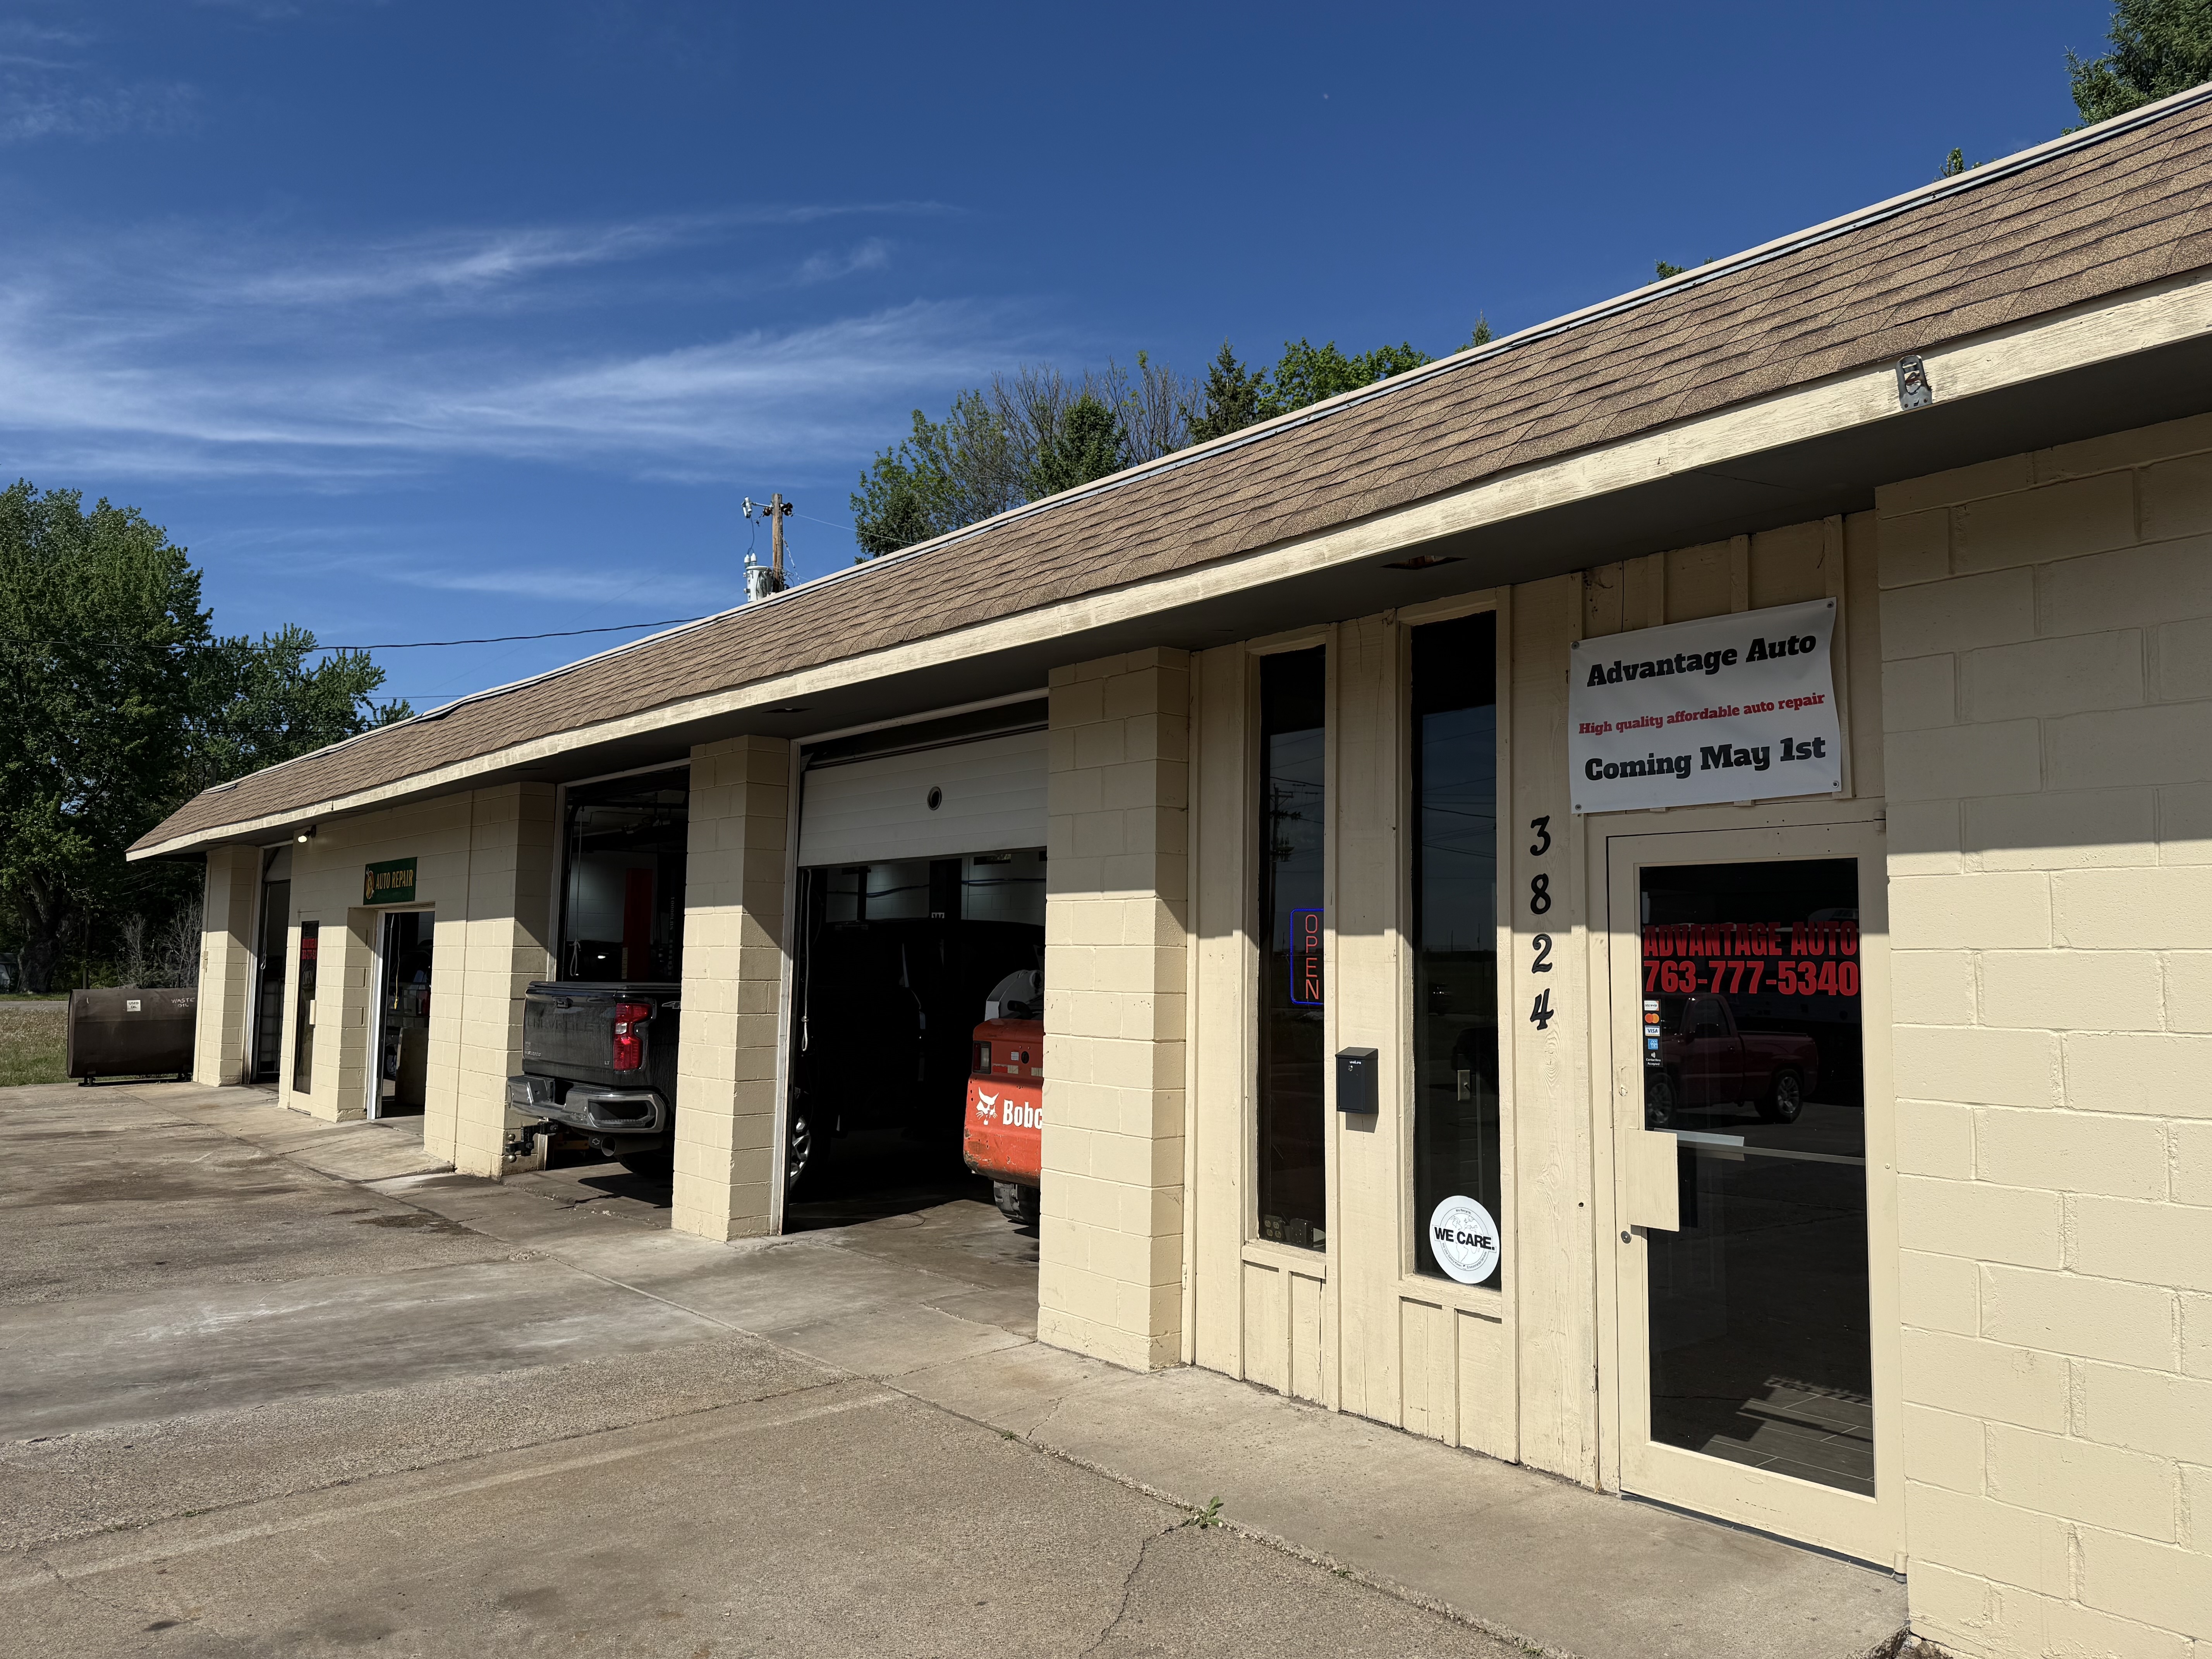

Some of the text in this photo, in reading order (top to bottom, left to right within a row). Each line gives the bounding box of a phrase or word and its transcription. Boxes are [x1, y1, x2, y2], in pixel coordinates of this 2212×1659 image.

[1587, 635, 1816, 687] Advantage Auto
[1578, 692, 1825, 735] High quality affordable auto repair
[1585, 737, 1826, 781] Coming May 1st
[376, 869, 413, 890] AUTO REPAIR
[1305, 914, 1319, 1000] OPEN
[1644, 921, 1858, 957] ADVANTAGE AUTO
[1644, 960, 1859, 996] 763-777-5340
[1434, 1226, 1495, 1250] WE CARE.
